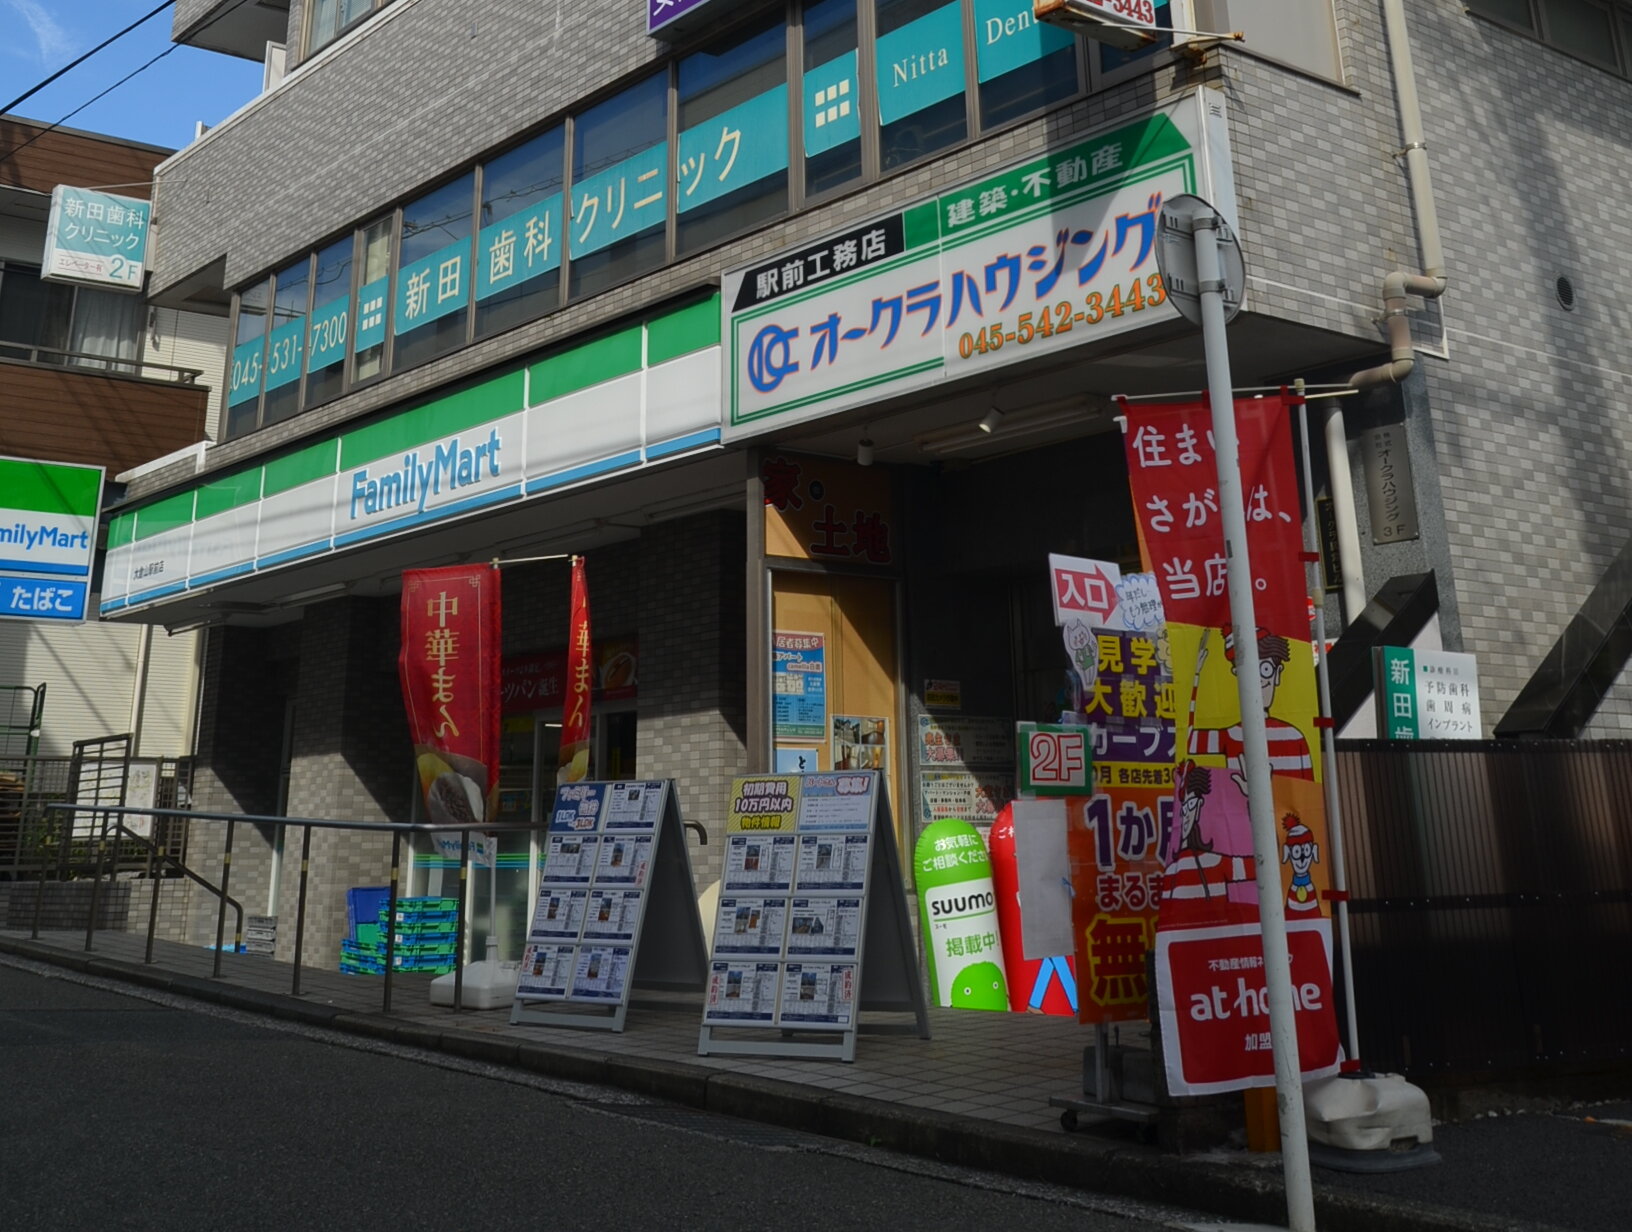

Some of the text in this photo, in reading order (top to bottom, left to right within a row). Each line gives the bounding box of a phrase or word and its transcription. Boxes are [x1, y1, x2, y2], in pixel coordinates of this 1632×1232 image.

[892, 6, 1040, 88] Nitta Dent
[947, 140, 1124, 228] 建築・不動産
[64, 197, 145, 230] 新田歯科
[64, 222, 140, 250] クリニック
[109, 257, 139, 280] 2F
[756, 229, 887, 300] 駅前工務店
[809, 191, 1164, 371] オークラハウジング
[959, 273, 1166, 360] 045-542-3443
[350, 428, 502, 520] FamilyMart
[1146, 484, 1292, 533] さがは、
[0, 523, 89, 550] milyMart
[1062, 573, 1110, 611] 入口
[1162, 553, 1267, 599] 当店。
[10, 585, 74, 612] たばこ
[425, 591, 460, 738] 中華まん
[569, 596, 589, 727] 華まん
[1097, 634, 1157, 675] 見学
[1425, 680, 1469, 697] 予防歯科
[1428, 718, 1472, 733] インプラント
[1030, 732, 1083, 783] 2F
[735, 797, 794, 813] 10万円以内
[743, 780, 788, 797] 初期費用
[934, 834, 979, 851] お気軽に
[922, 850, 988, 872] ご相談くださ
[931, 890, 994, 916] suumo
[1208, 954, 1294, 972] 不動産情報ネ
[1190, 985, 1231, 1021] at
[1245, 1032, 1273, 1051] 加盟
